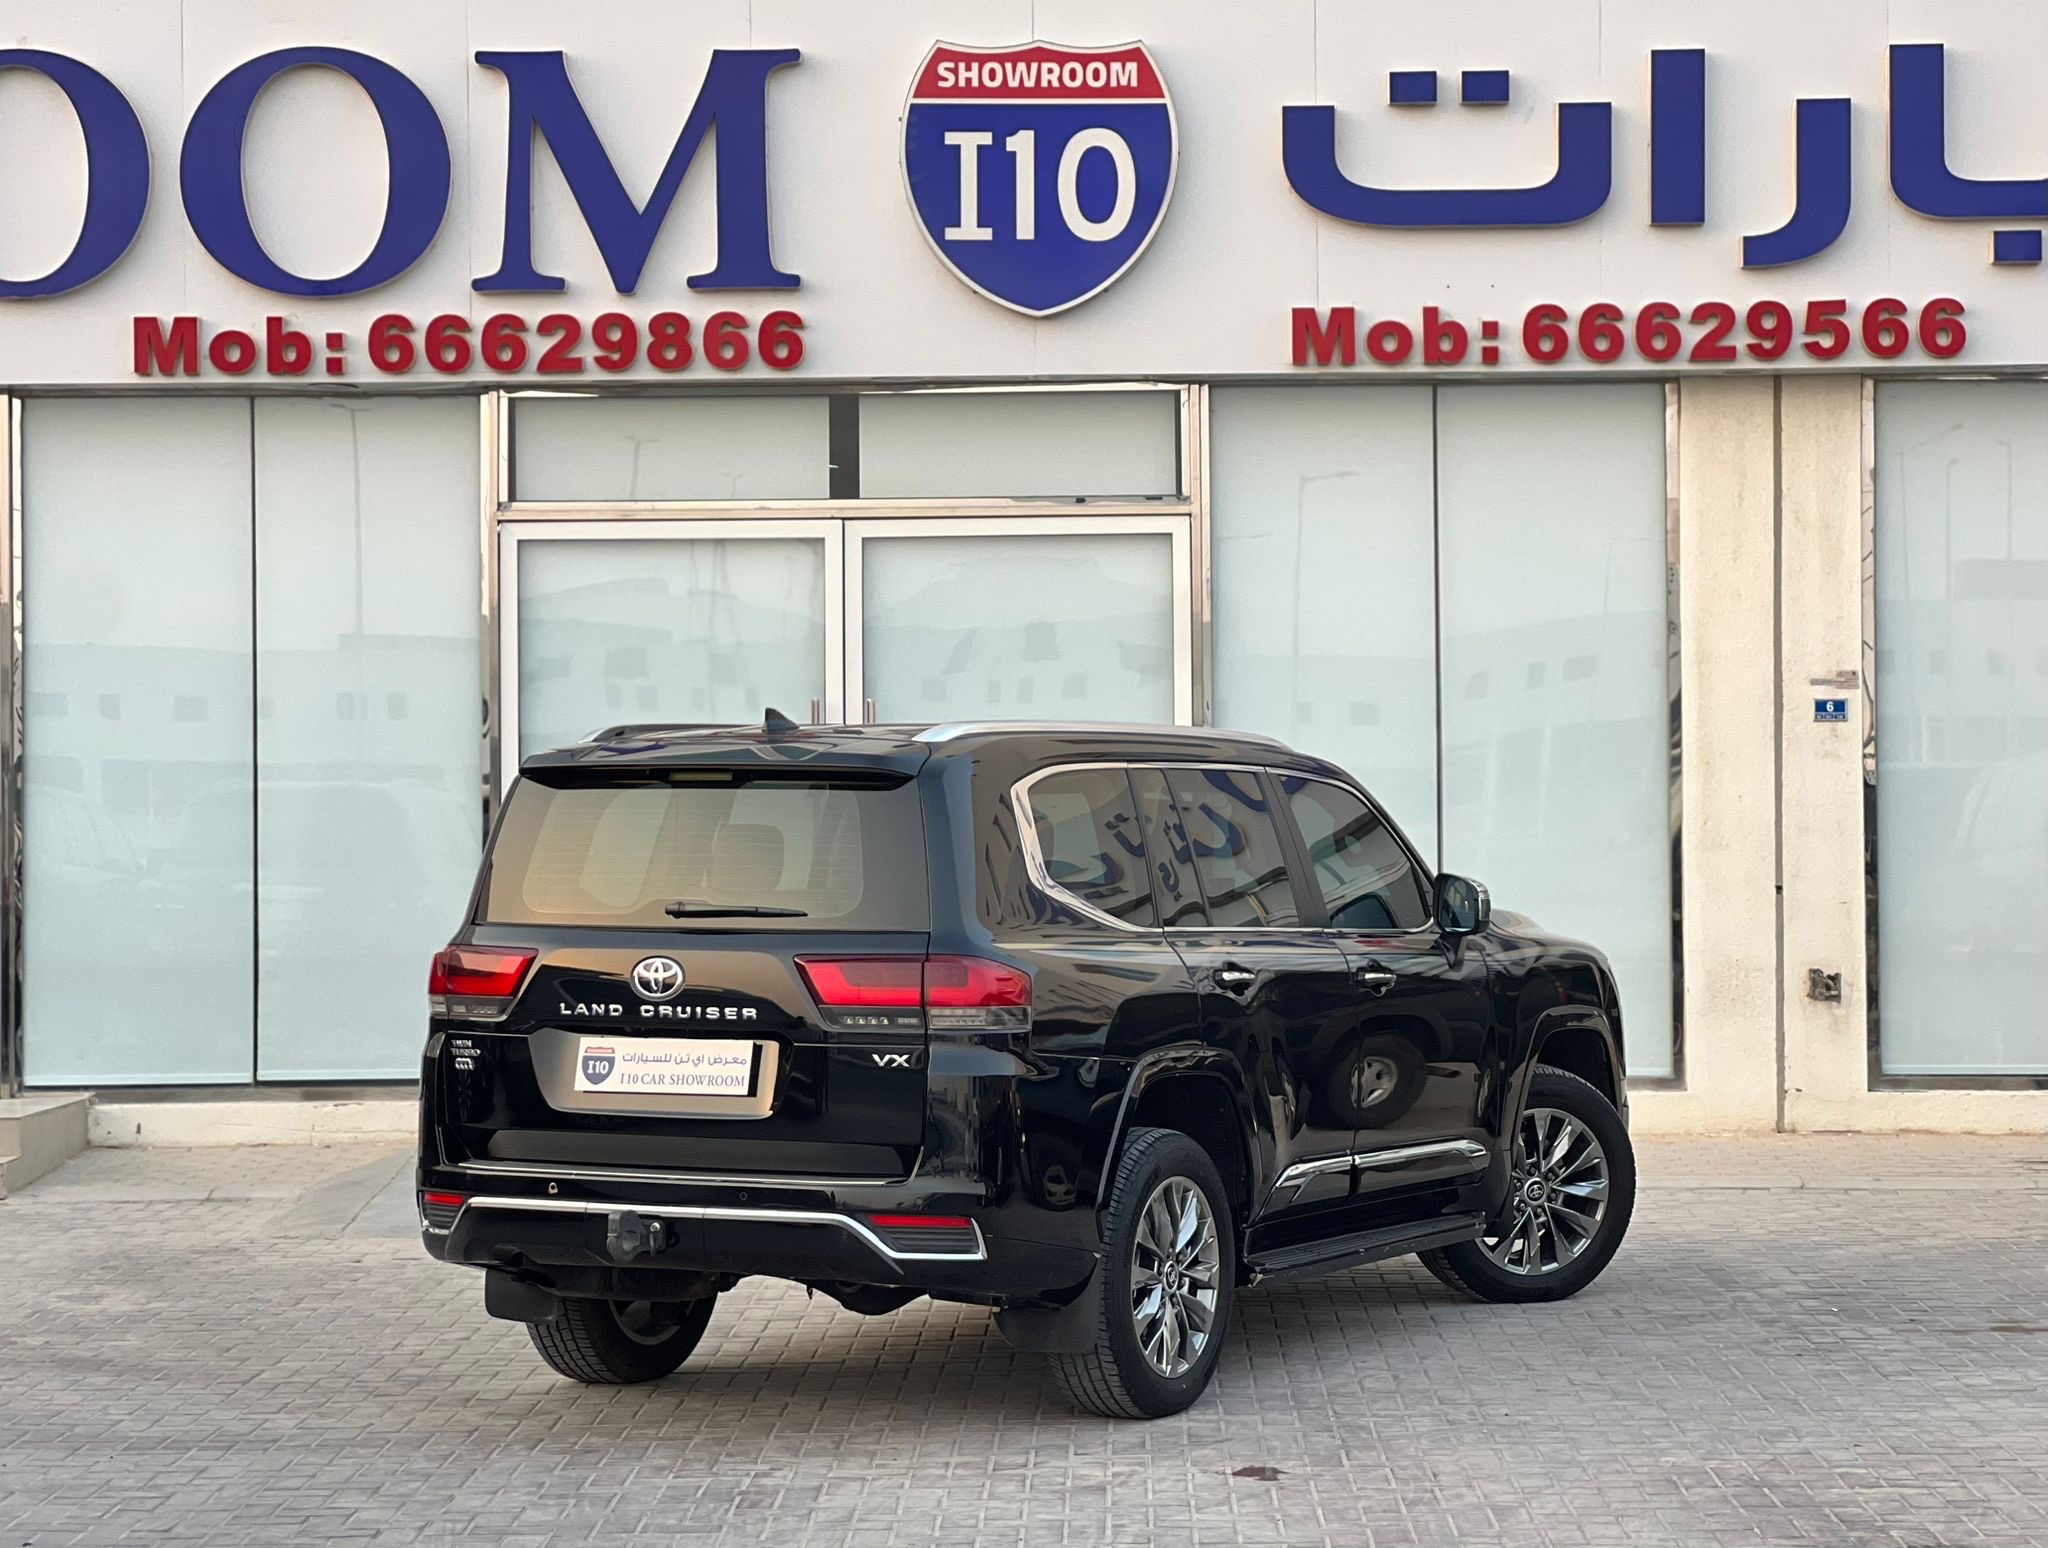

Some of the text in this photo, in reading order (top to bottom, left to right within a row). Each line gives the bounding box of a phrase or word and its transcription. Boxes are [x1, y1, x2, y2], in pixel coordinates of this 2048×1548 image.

[936, 60, 1139, 89] SHOWROOM
[944, 126, 1137, 243] I10
[1293, 300, 1965, 363] Mob: 66629566
[135, 312, 803, 373] Mob: 66629866
[1826, 701, 1834, 712] 6
[559, 1002, 758, 1021] LAND CRUISER
[587, 1060, 610, 1075] I10
[871, 1053, 911, 1068] VX
[641, 1073, 666, 1086] CAR
[669, 1074, 746, 1088] SHOWROOM
